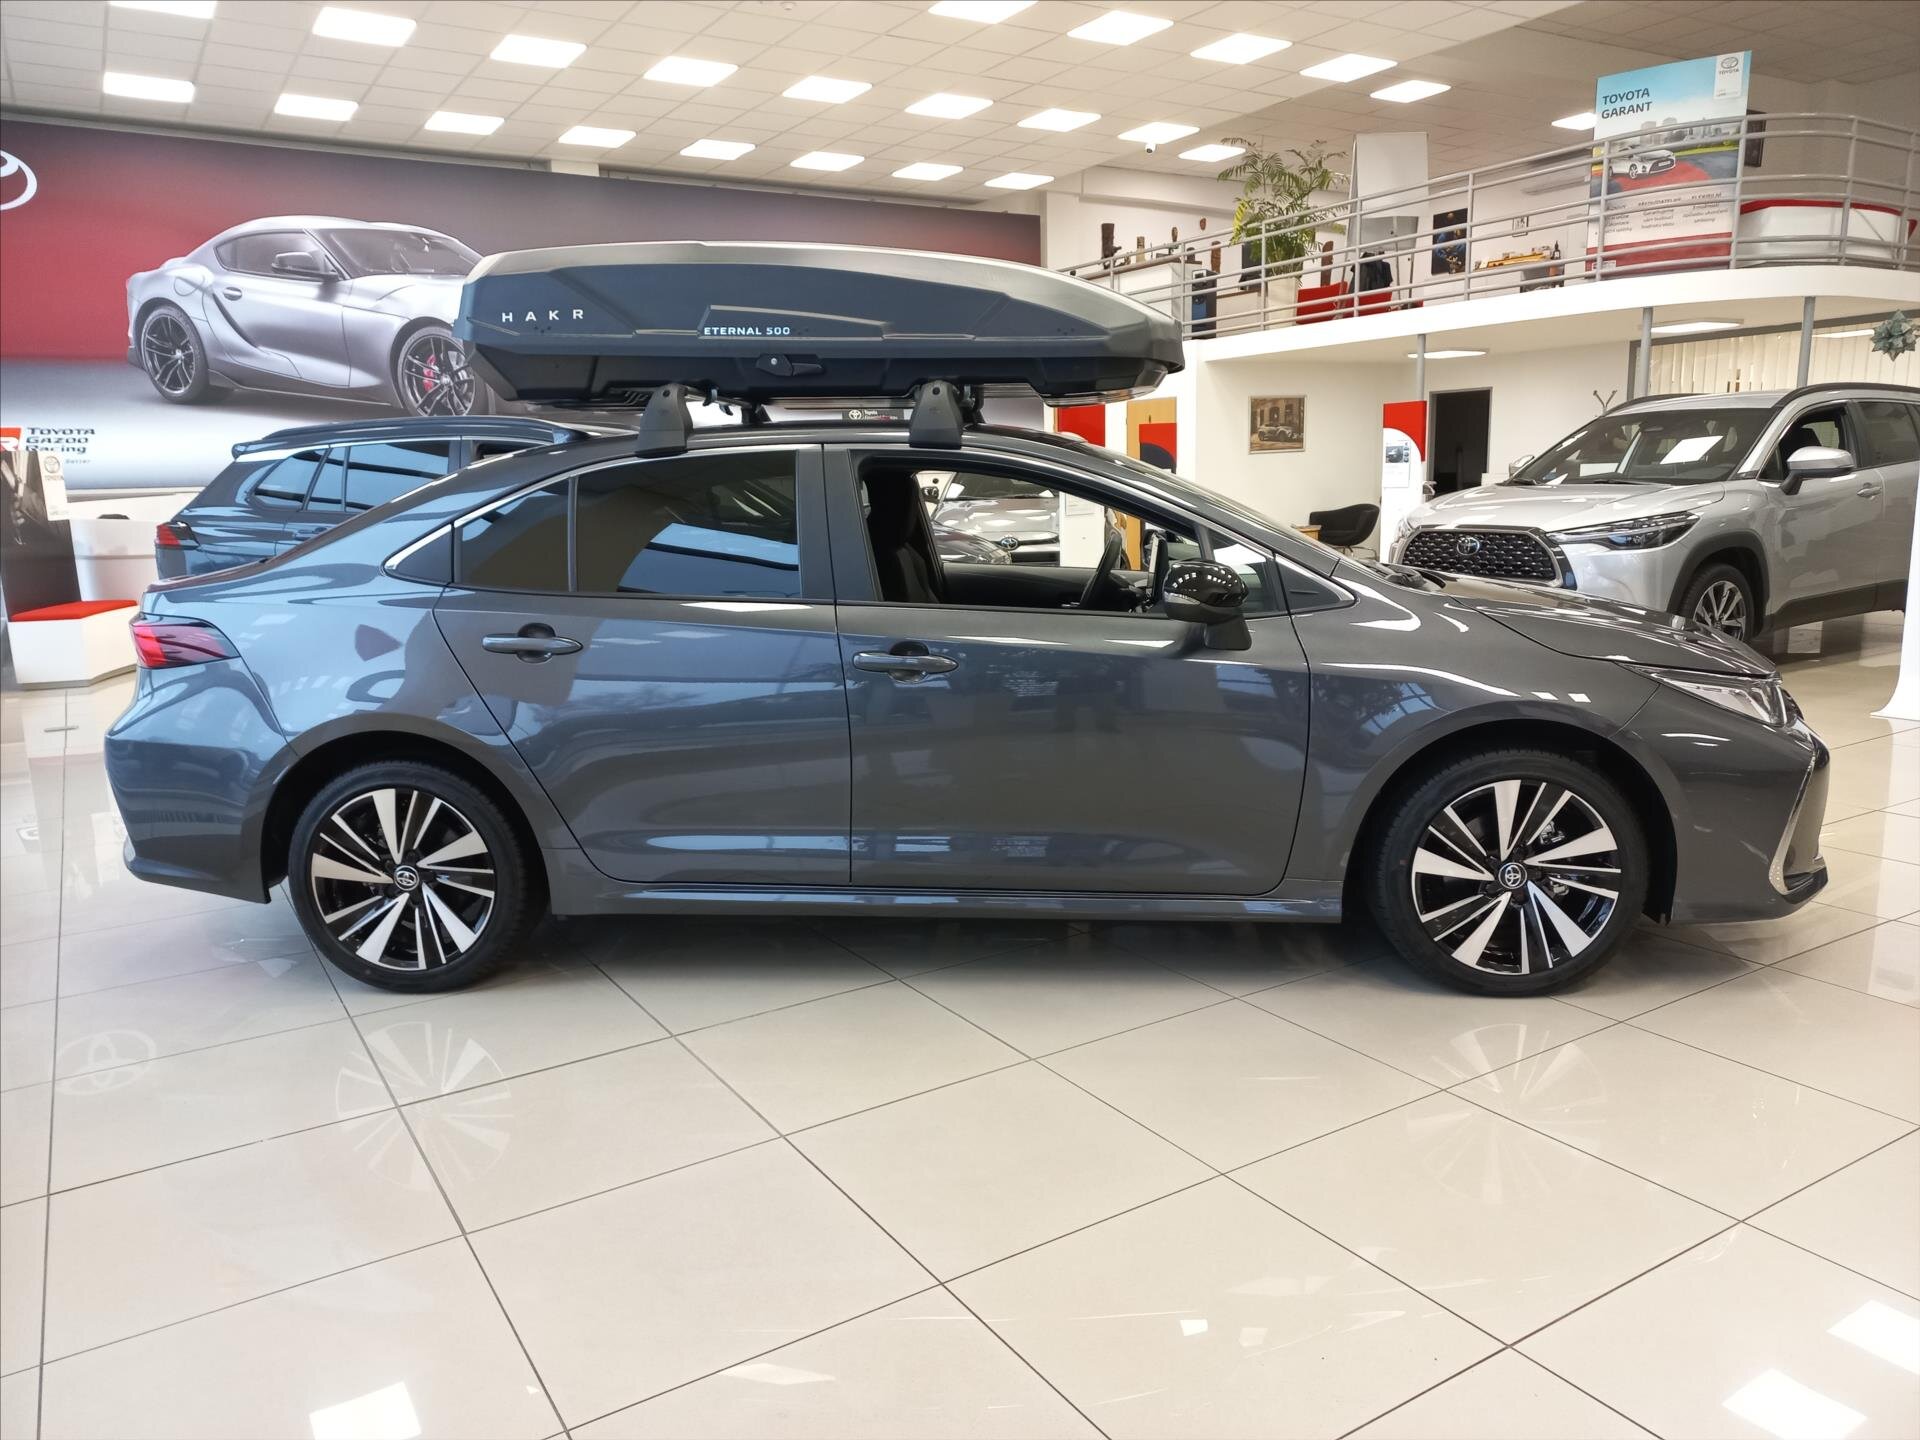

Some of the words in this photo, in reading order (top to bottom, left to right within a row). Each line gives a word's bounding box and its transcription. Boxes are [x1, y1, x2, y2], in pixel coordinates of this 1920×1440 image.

[1602, 87, 1650, 106] TOYOTA
[1601, 101, 1653, 120] GARANT
[501, 309, 584, 323] HAKR
[703, 326, 762, 336] ETERNAL
[766, 326, 791, 336] 500
[27, 427, 96, 435] TOYOTA
[26, 436, 89, 444] GAZOO
[25, 445, 87, 455] Racing
